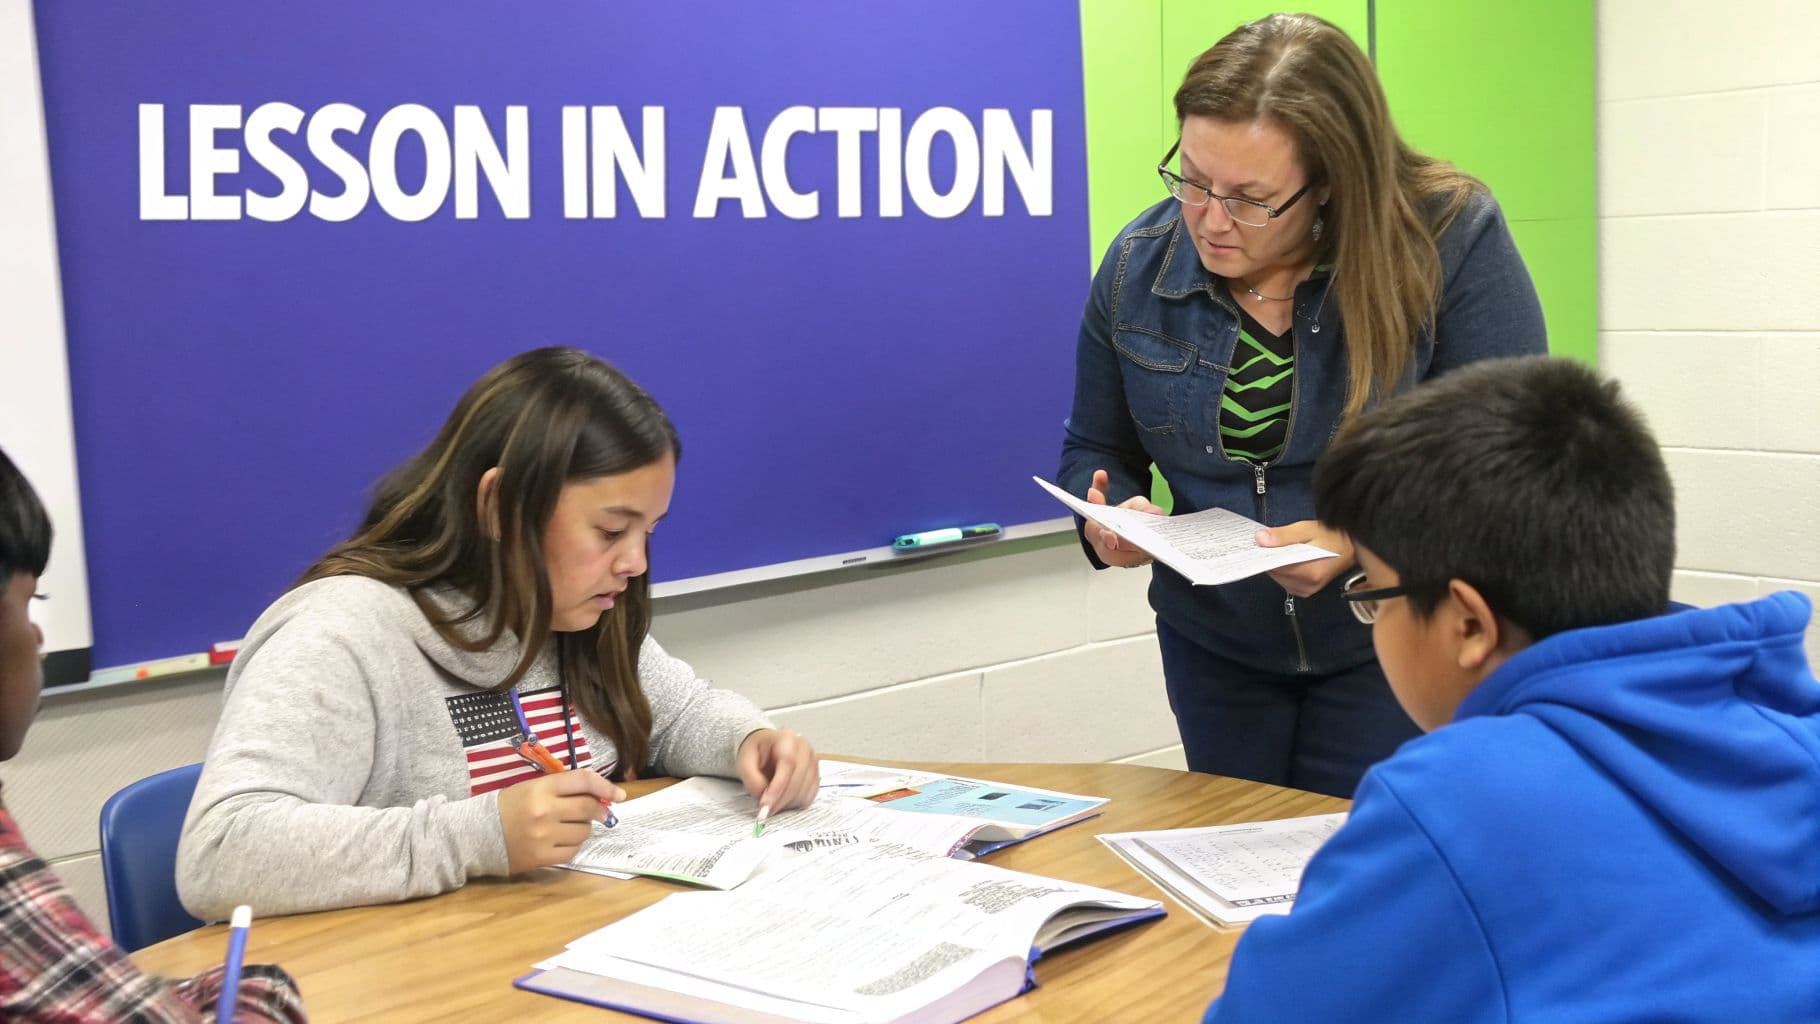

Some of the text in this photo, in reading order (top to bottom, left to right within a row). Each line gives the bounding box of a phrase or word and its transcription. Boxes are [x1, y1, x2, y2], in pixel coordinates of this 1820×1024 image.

[139, 102, 1053, 221] LESSON IN ACTION
